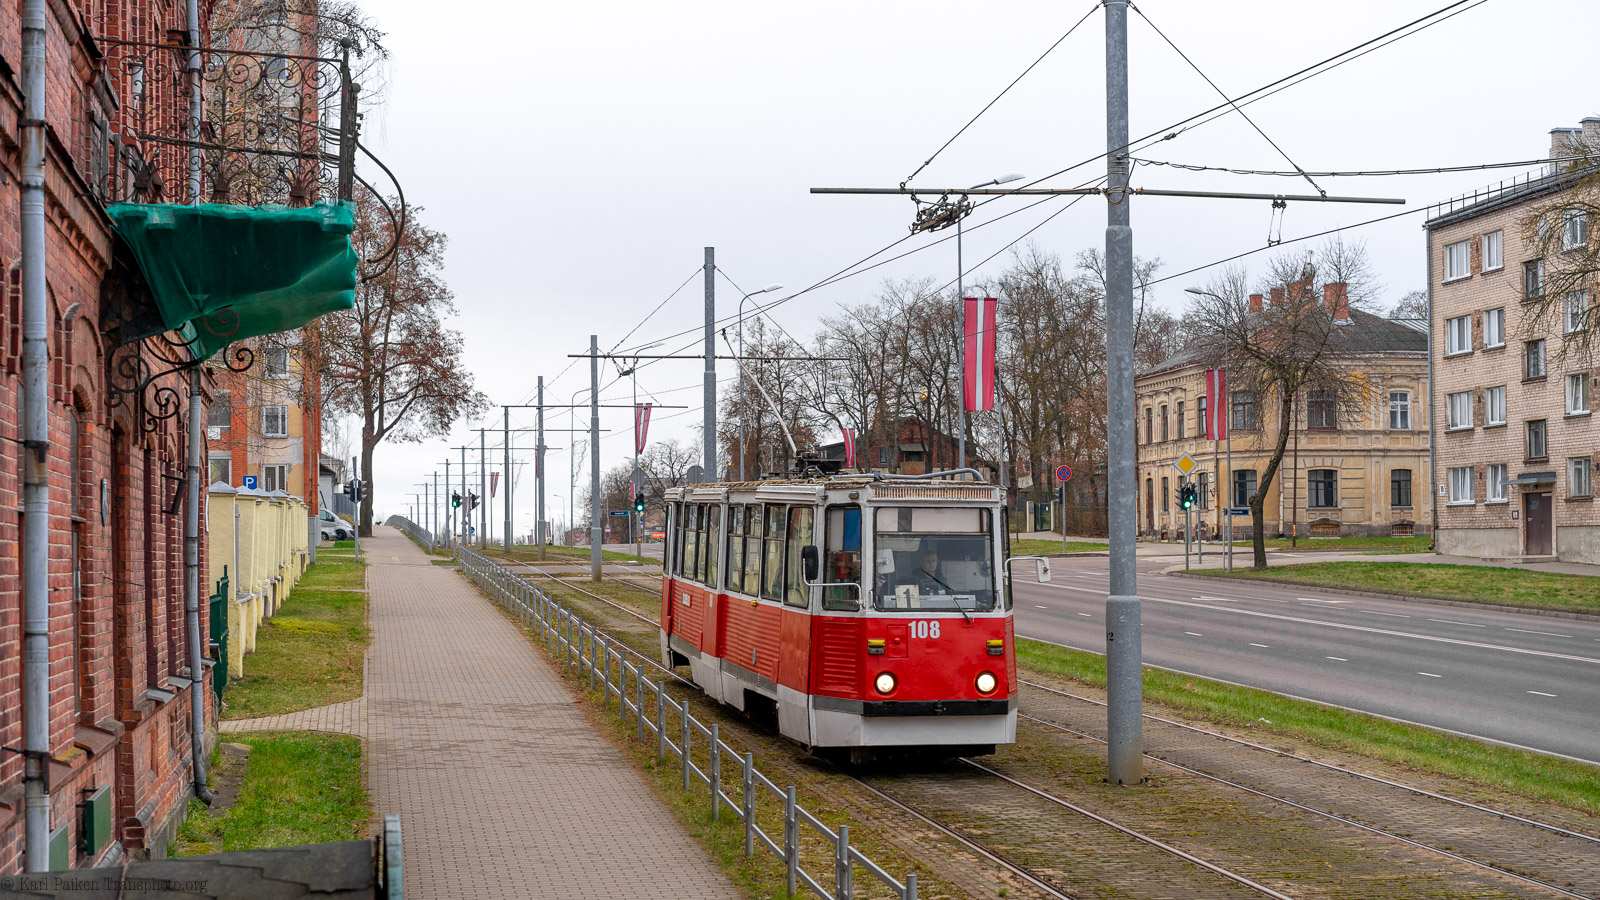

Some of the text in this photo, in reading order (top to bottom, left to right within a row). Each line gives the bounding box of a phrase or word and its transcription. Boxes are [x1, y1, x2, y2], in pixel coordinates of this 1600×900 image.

[246, 477, 254, 488] P
[903, 588, 911, 608] 1
[908, 620, 940, 639] 108
